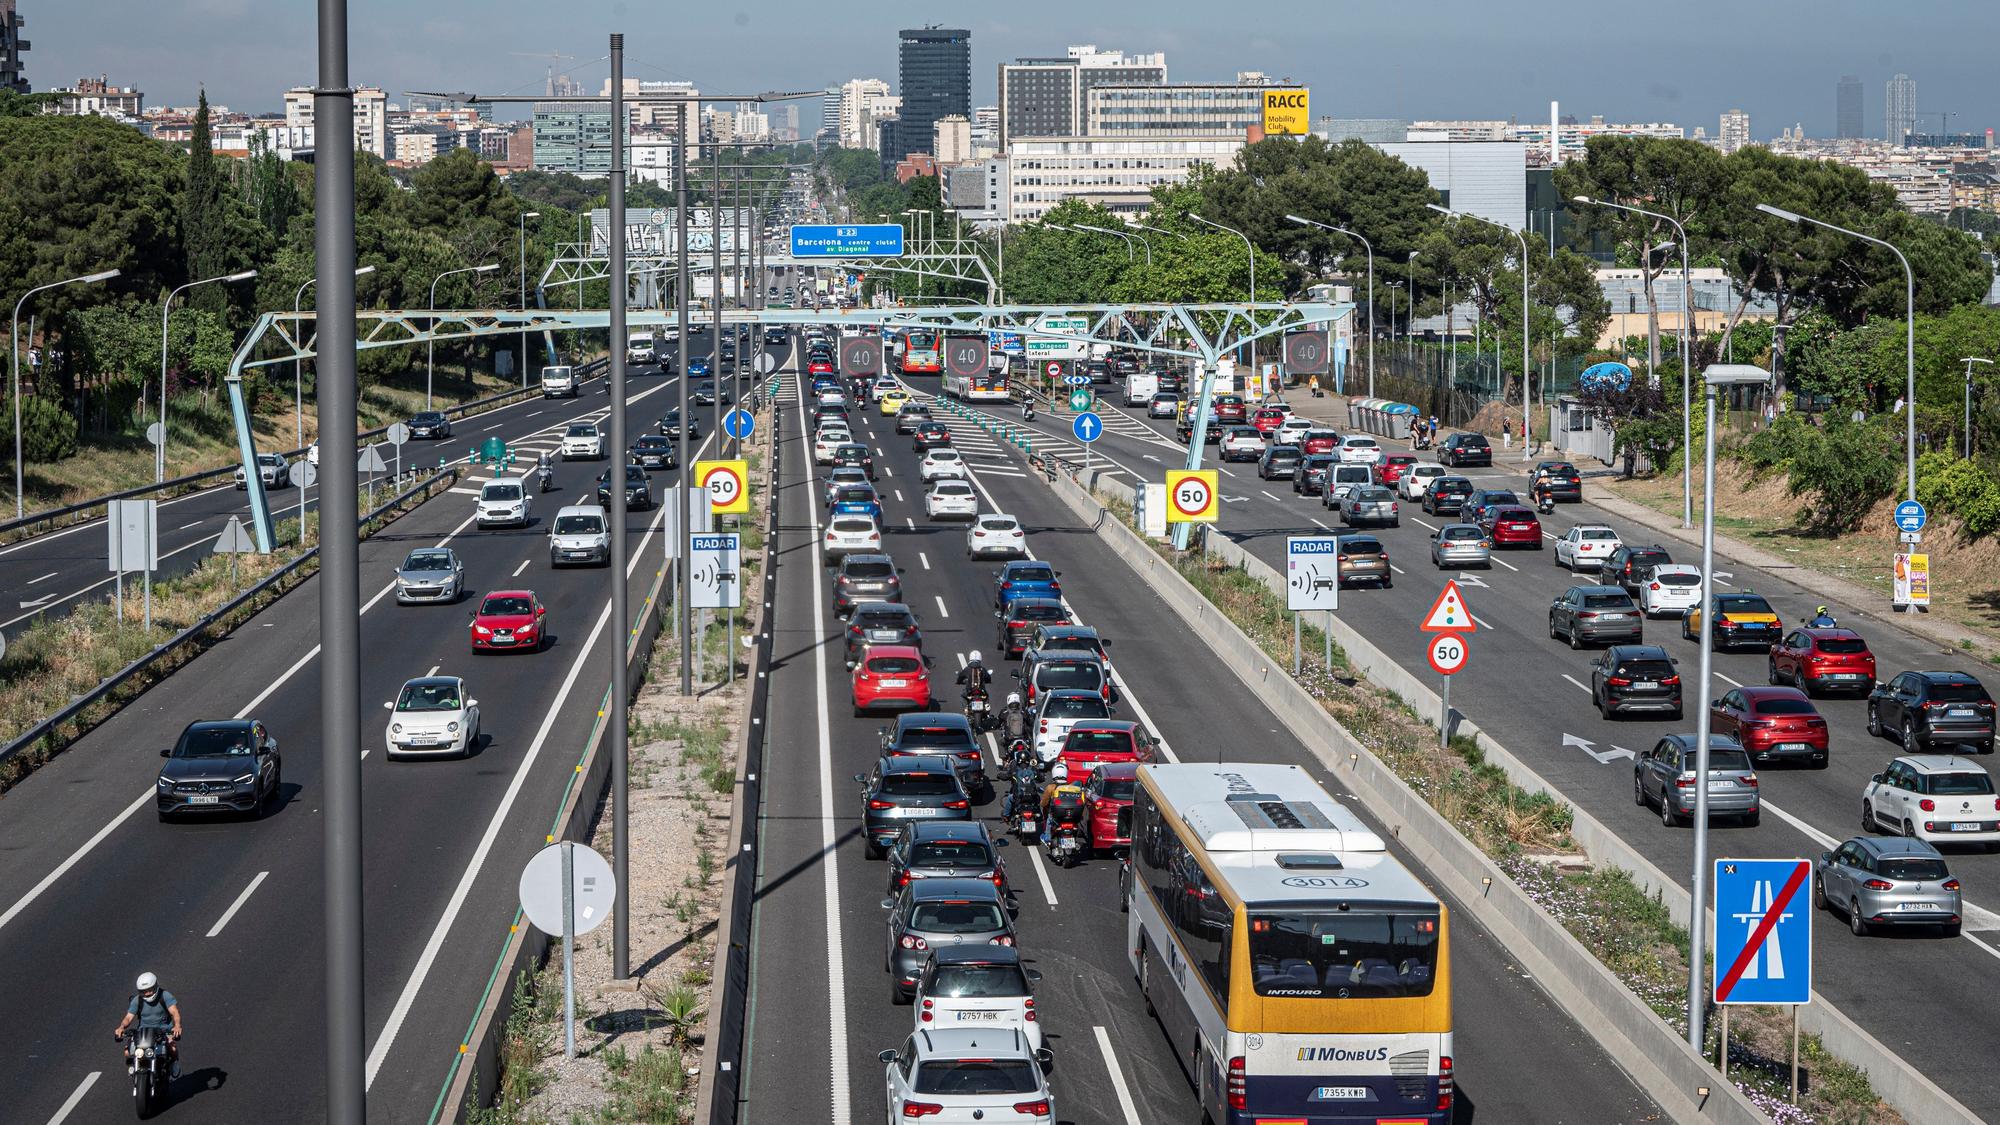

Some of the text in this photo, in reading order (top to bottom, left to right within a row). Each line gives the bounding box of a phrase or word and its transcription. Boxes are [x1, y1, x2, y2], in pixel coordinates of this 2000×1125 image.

[1268, 95, 1305, 108] RACC
[852, 350, 870, 365] 40
[958, 348, 976, 364] 40
[1298, 345, 1315, 360] 40
[712, 481, 733, 493] 50
[1182, 490, 1203, 503] 50
[696, 539, 735, 549] RADAR
[1293, 542, 1332, 552] RADAR
[1438, 646, 1459, 660] 50
[1293, 878, 1359, 887] 3014
[962, 1012, 998, 1020] 2757 HBK
[1324, 1087, 1364, 1097] 7355 KWR
